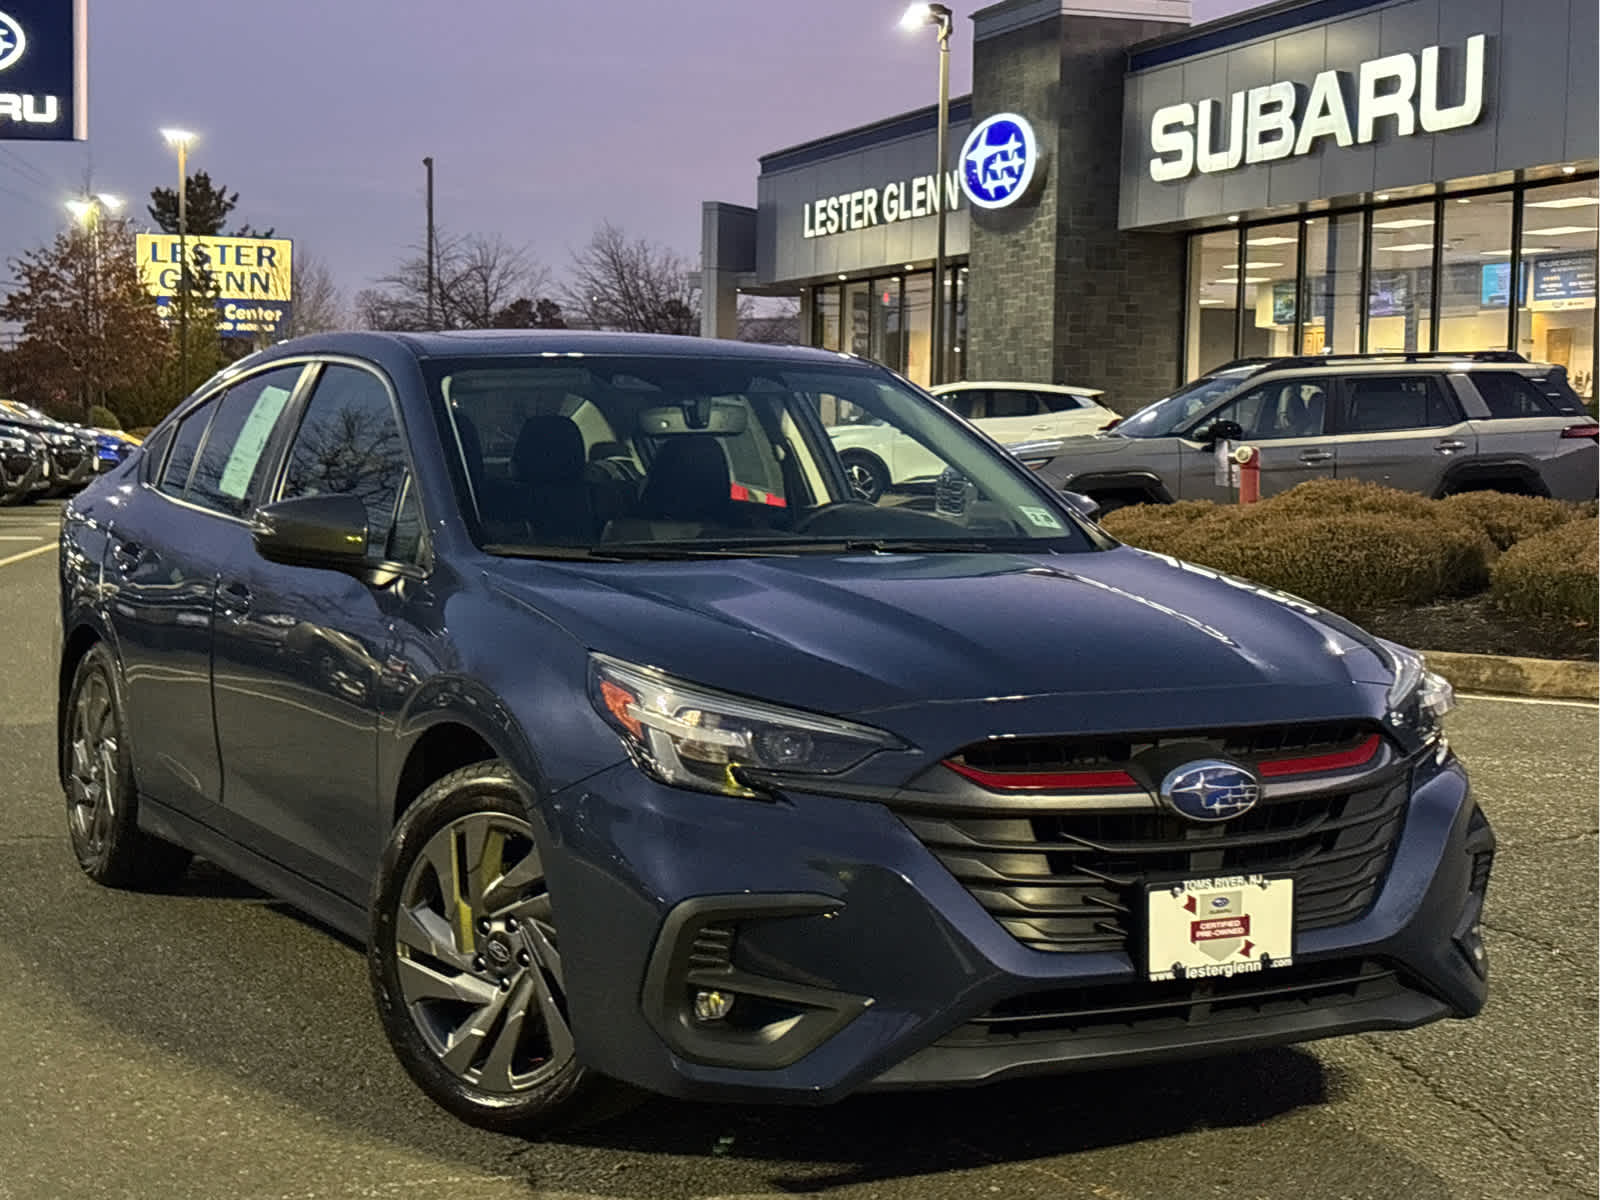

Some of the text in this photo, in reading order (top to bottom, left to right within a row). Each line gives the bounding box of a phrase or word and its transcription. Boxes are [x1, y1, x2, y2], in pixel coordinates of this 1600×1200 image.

[1150, 34, 1486, 183] SUBARU
[803, 170, 959, 238] LESTER GLENN
[151, 242, 277, 268] LESTER
[224, 303, 283, 322] Center
[1183, 878, 1212, 891] TOMS
[1195, 927, 1245, 938] PRE-OWNED
[1200, 919, 1241, 930] CERTIFIED
